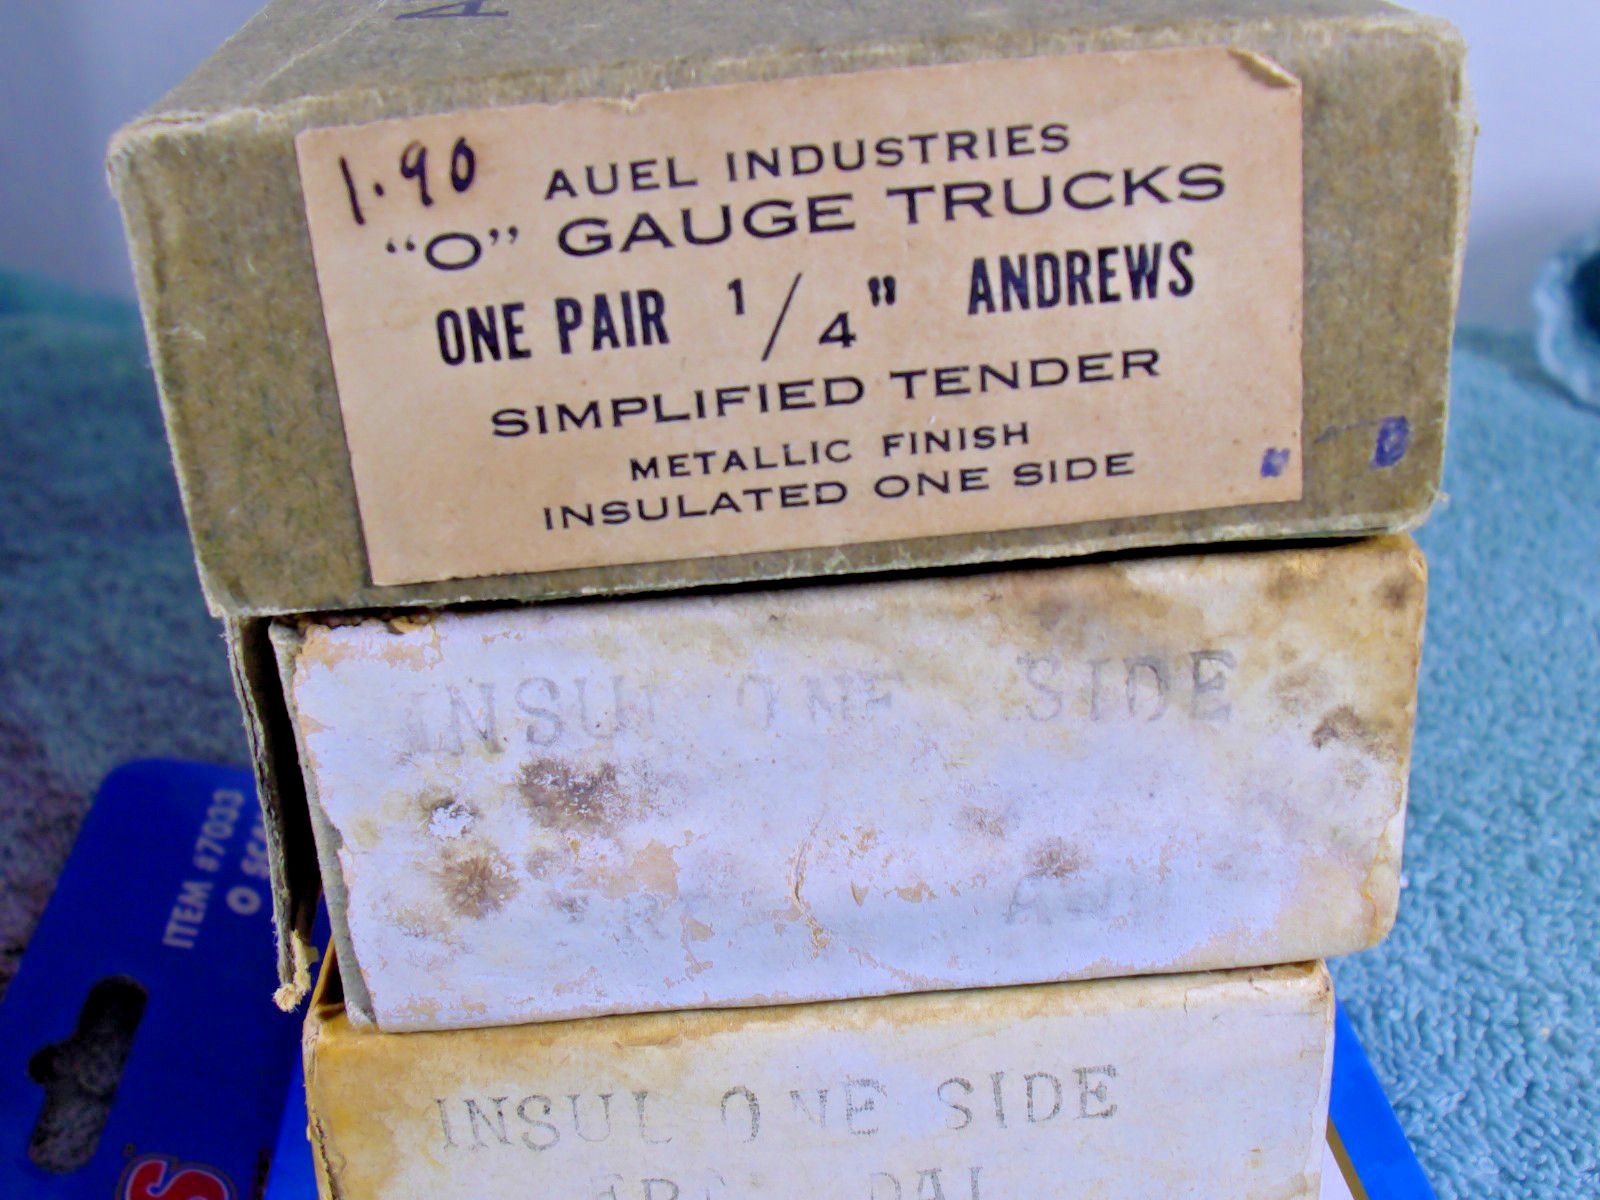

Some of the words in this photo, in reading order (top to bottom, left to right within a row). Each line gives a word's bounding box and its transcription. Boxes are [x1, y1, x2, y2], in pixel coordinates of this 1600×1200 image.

[339, 136, 476, 226] 1.90
[544, 156, 698, 200] AUEL
[726, 123, 1071, 182] INDUSTRIES
[557, 193, 855, 257] GAUGE
[886, 162, 1226, 225] TRUCKS
[436, 303, 532, 366] ONE
[554, 288, 670, 355] PAIR
[967, 240, 1195, 316] ANDREWS
[491, 376, 865, 438] SIMPLIFIED
[890, 348, 1161, 400] TENDER
[543, 481, 848, 531] INSULATED
[874, 466, 990, 500] ONE
[1013, 452, 1136, 487] SIDE
[629, 439, 853, 482] METALLIC
[883, 422, 1030, 457] FINISH
[1018, 648, 1238, 723] SIDE
[162, 880, 214, 950] ITEM
[225, 886, 262, 916] O
[433, 1090, 673, 1151] INSUL
[720, 1074, 888, 1144] ONE
[936, 1063, 1119, 1130] SIDE
